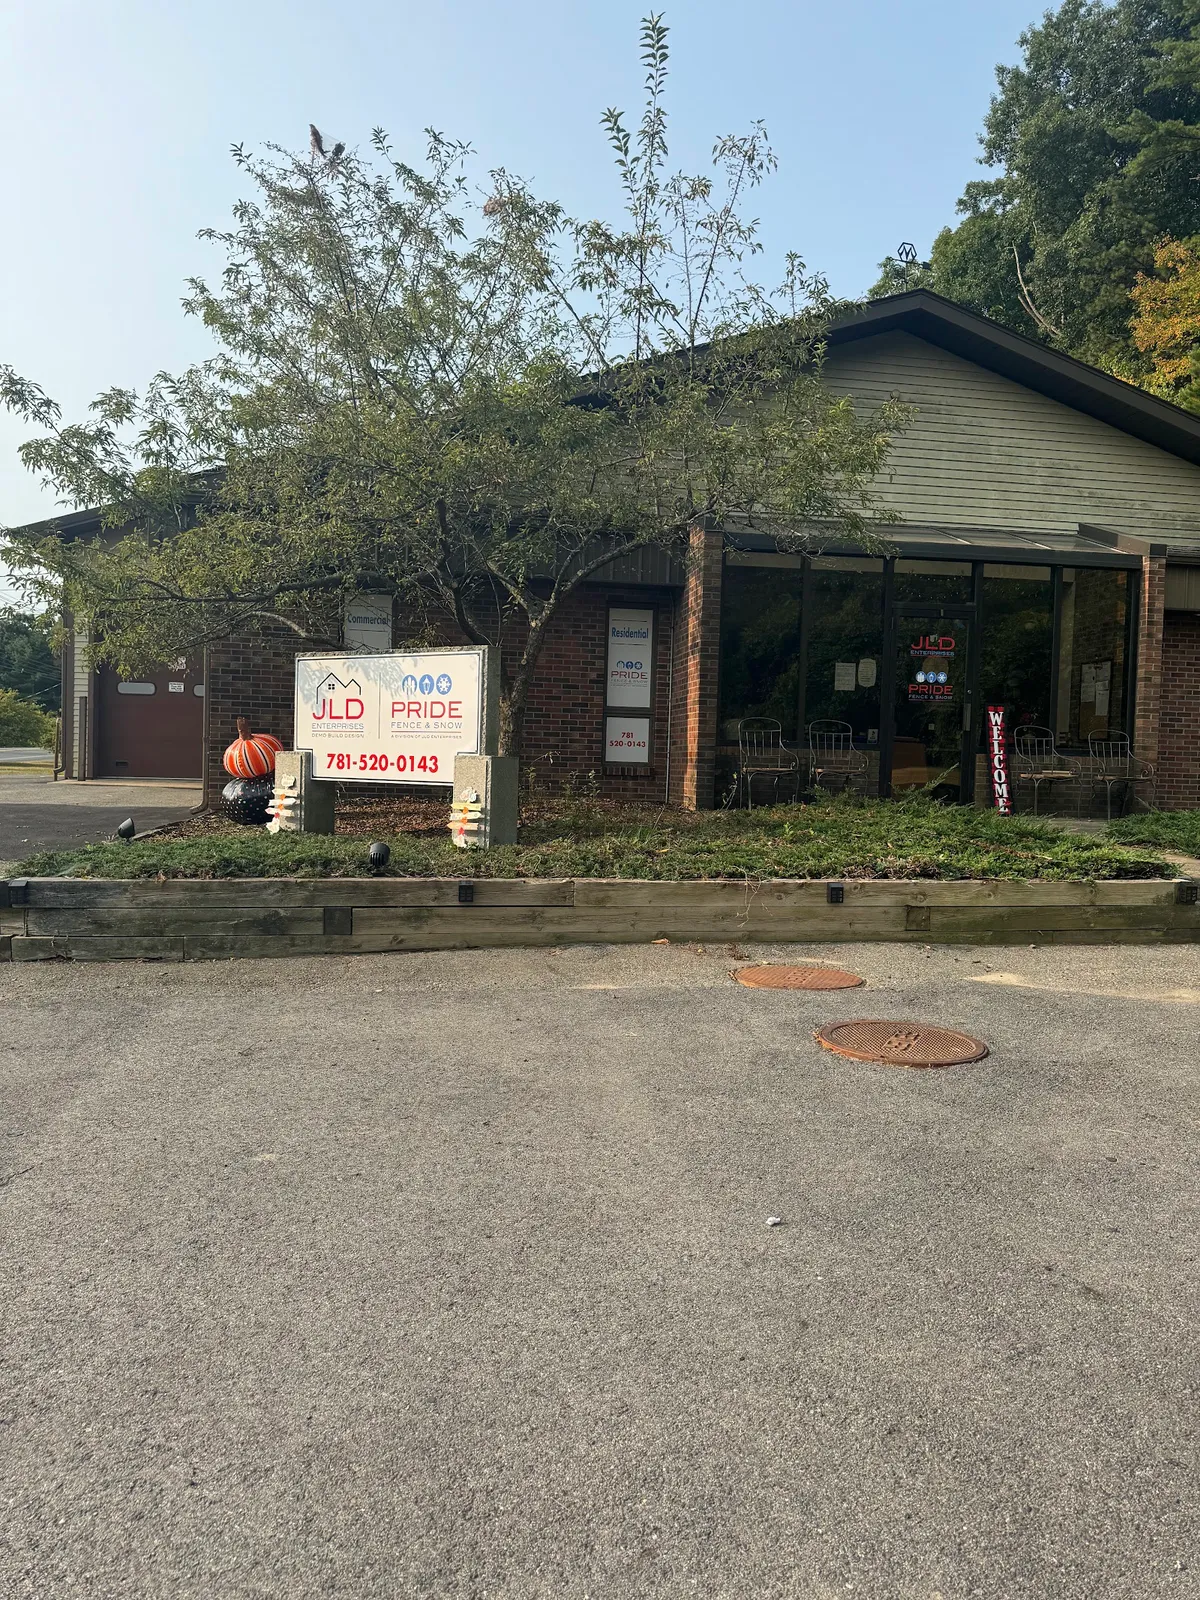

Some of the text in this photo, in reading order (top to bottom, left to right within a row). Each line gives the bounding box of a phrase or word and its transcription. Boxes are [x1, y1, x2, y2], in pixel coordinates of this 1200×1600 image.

[611, 626, 649, 639] Residential
[911, 636, 955, 650] JLD
[611, 670, 648, 680] PRIDE
[908, 684, 953, 695] PRIDE
[312, 698, 364, 720] JLD
[391, 701, 463, 719] PRIDE
[311, 722, 364, 730] ENTERPRISES
[391, 721, 463, 729] FENCE & SNOW
[609, 740, 646, 748] 520-0143
[326, 753, 439, 774] 781-520-0143
[989, 711, 1008, 812] WELCOME
